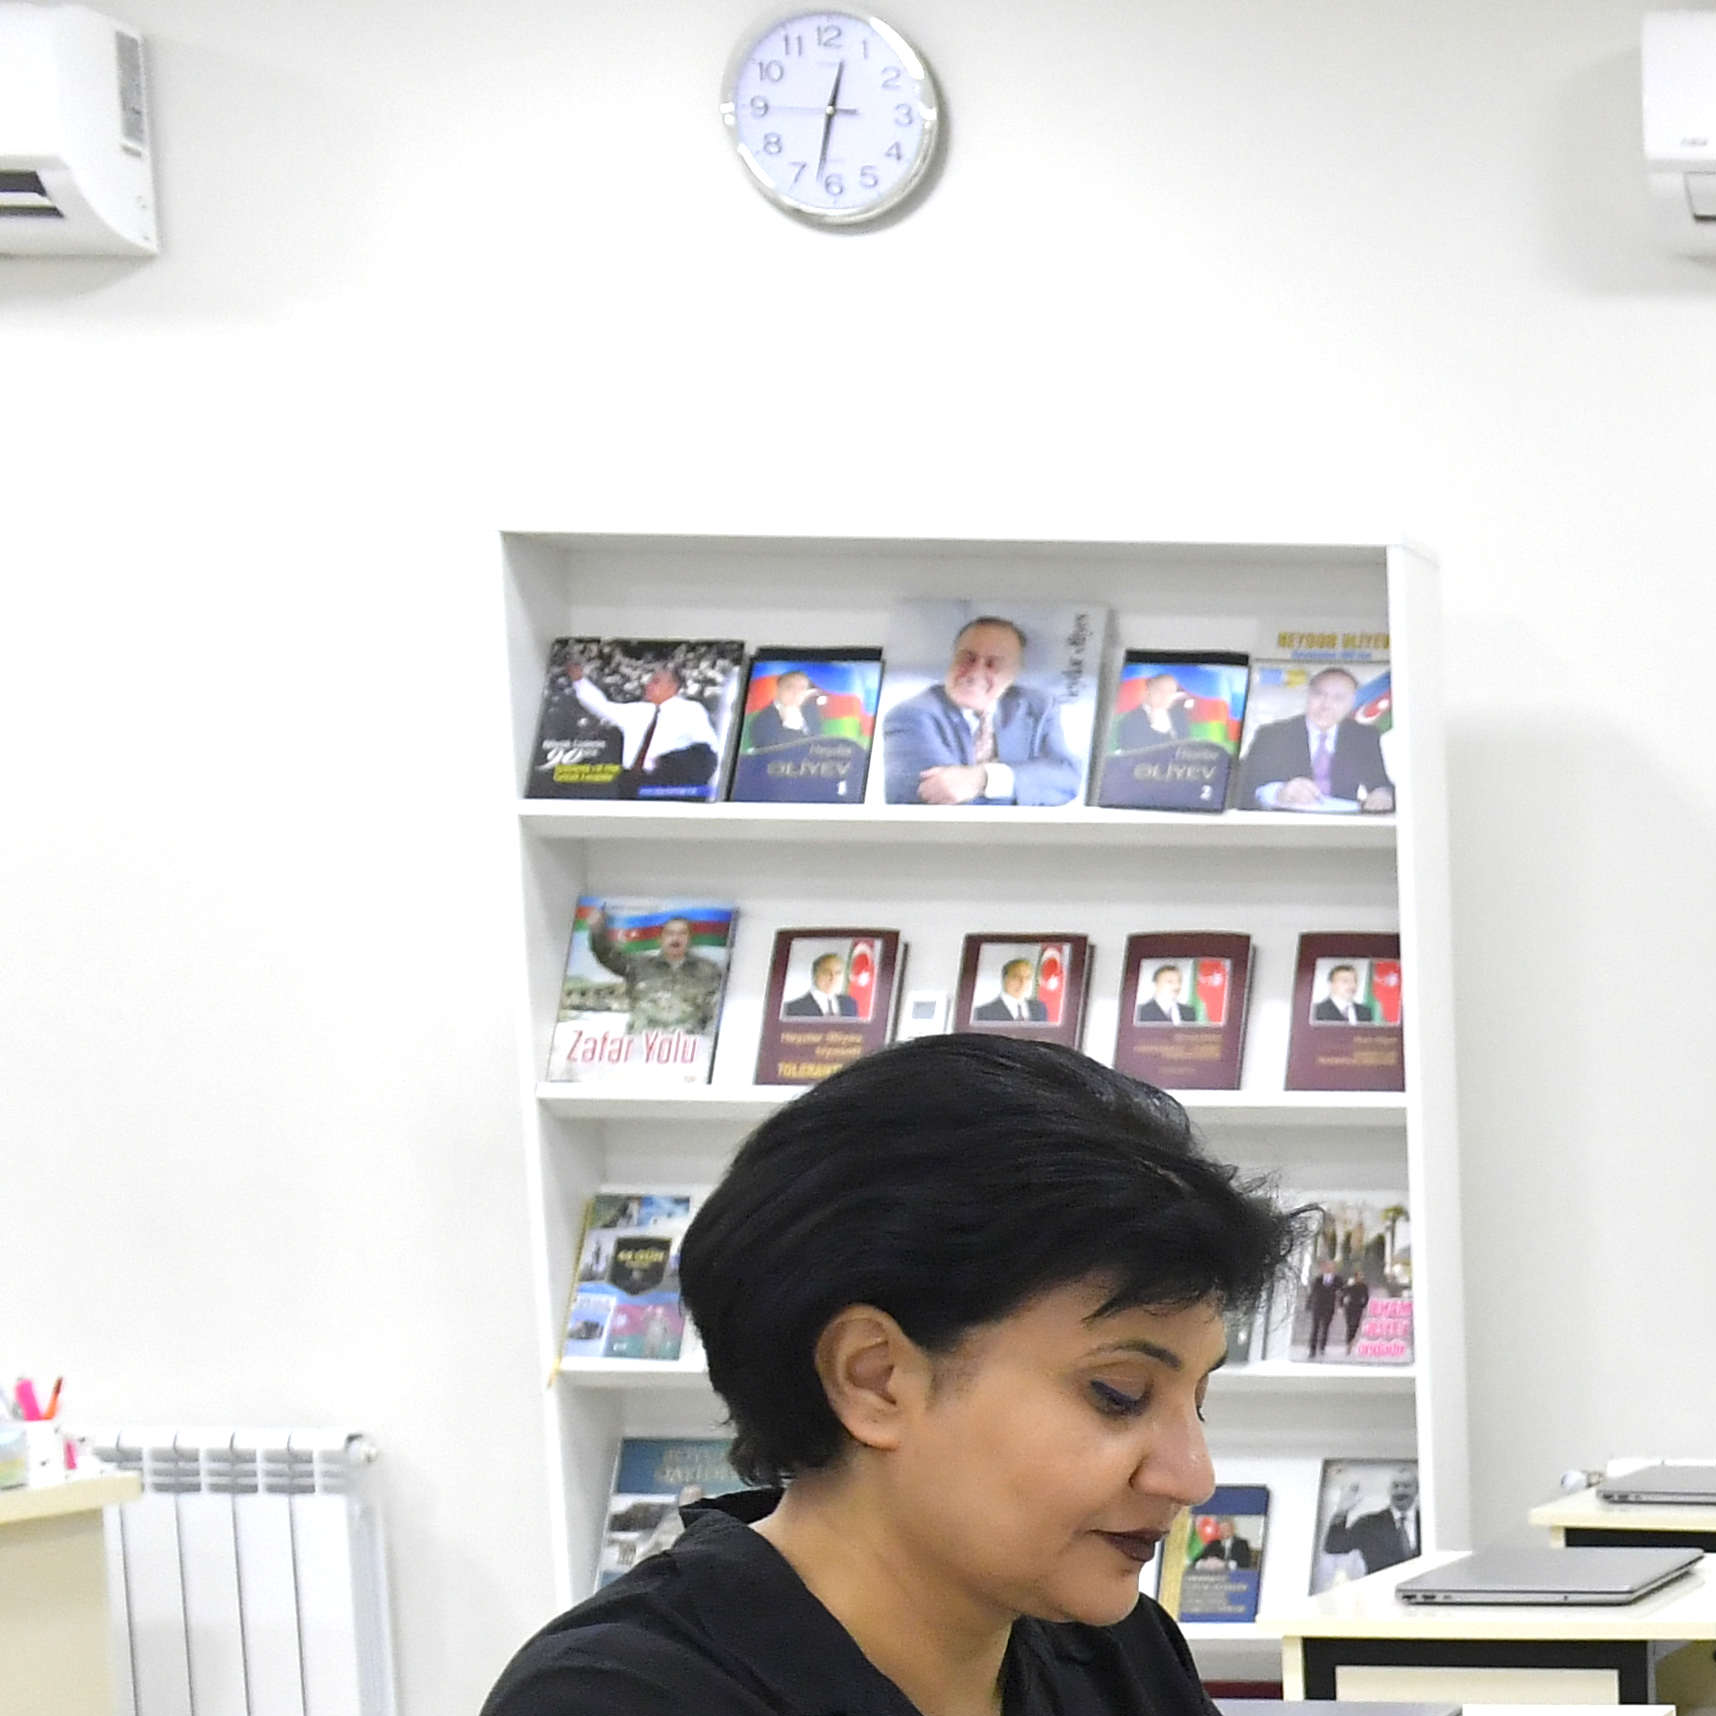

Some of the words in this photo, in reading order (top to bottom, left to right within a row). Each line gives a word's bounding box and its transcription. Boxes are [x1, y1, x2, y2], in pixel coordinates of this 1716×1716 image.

[783, 34, 803, 56] 11
[816, 25, 843, 48] 12
[758, 60, 784, 82] 10
[881, 66, 900, 89] 2
[750, 96, 769, 118] 9
[894, 103, 913, 127] 3
[762, 132, 782, 155] 8
[885, 141, 902, 161] 4
[789, 161, 807, 184] 7
[859, 165, 879, 188] 5
[824, 174, 844, 196] 6
[643, 1030, 699, 1065] Yolu
